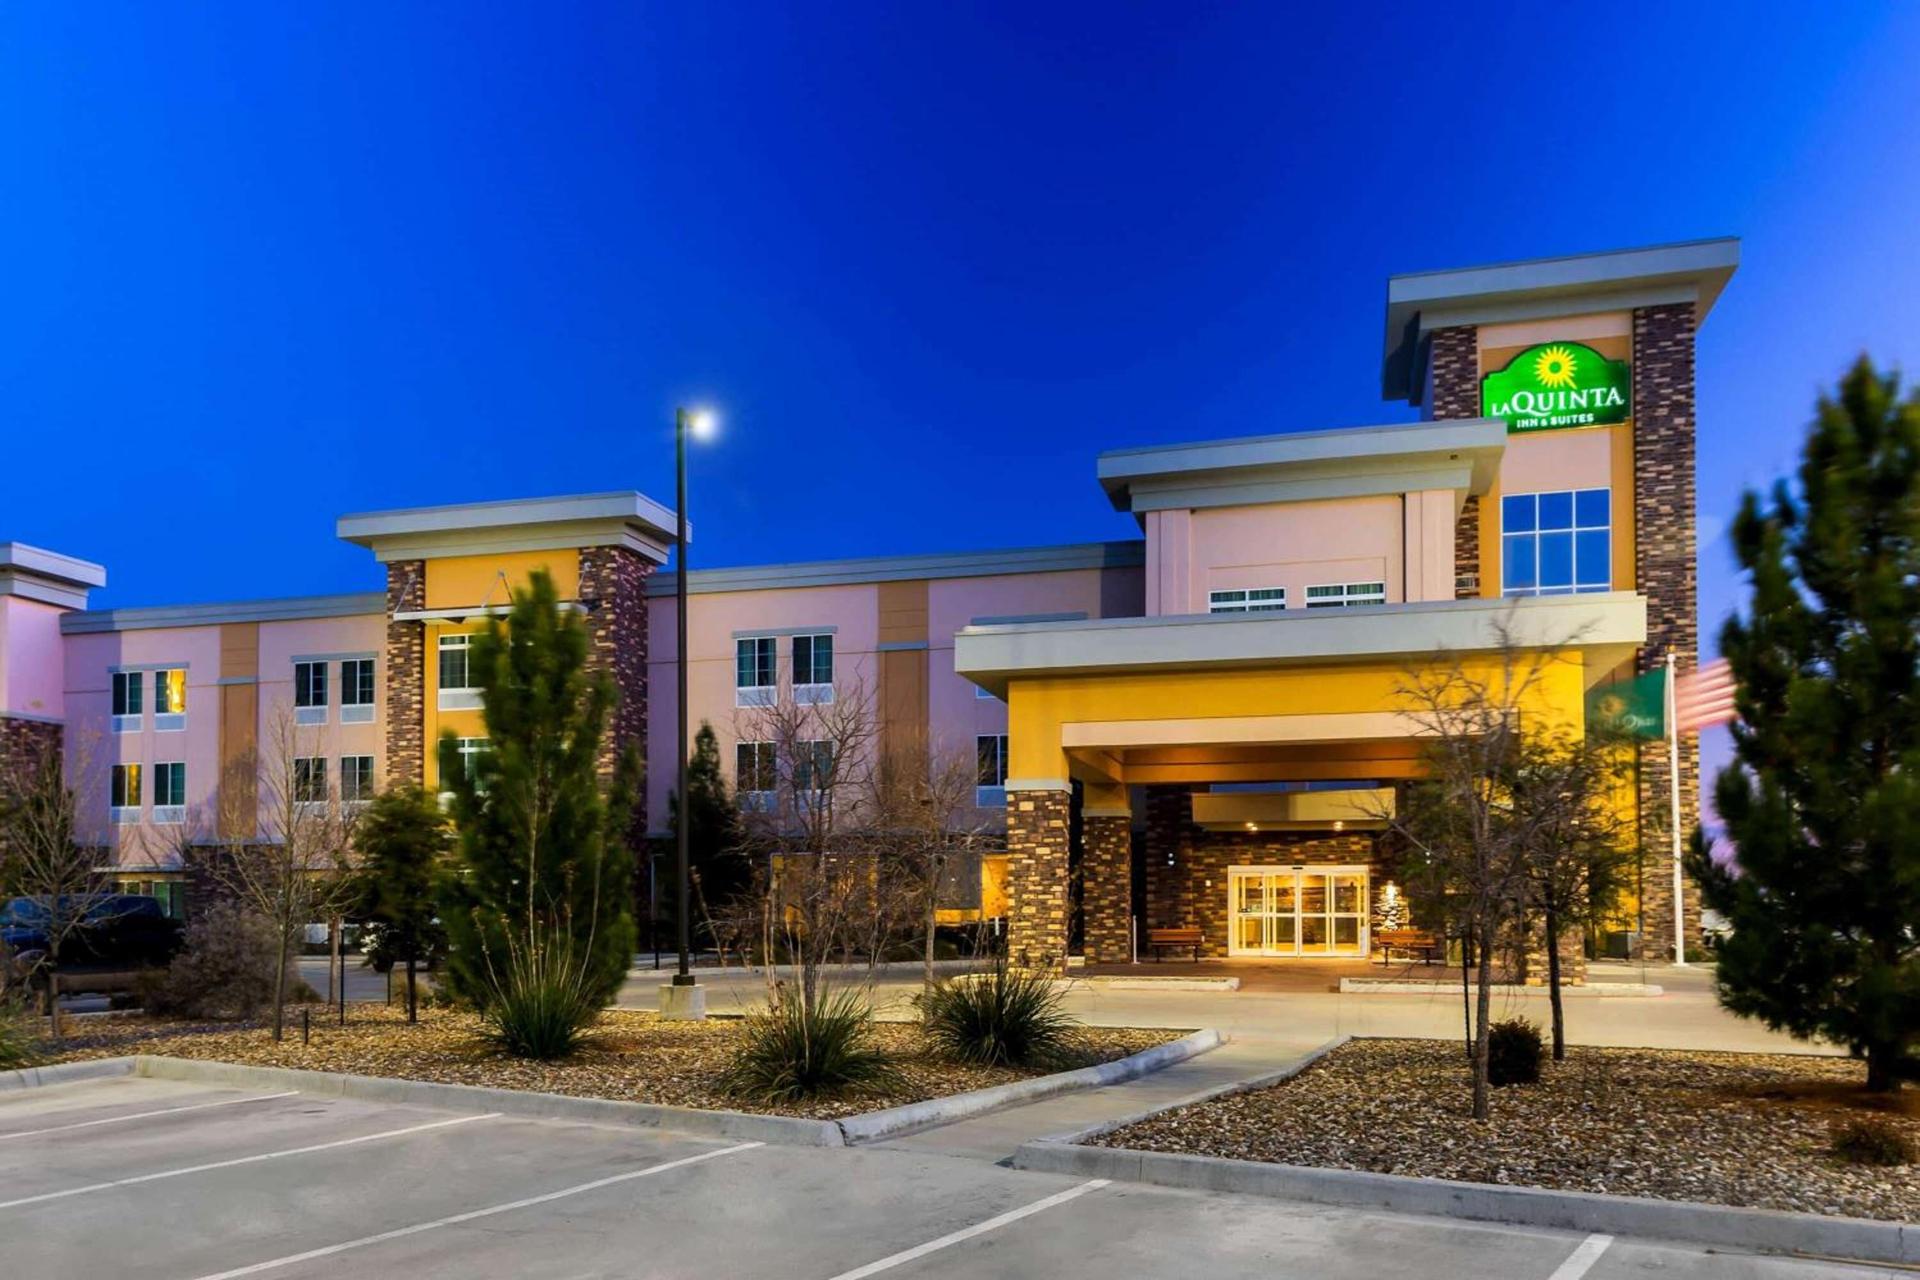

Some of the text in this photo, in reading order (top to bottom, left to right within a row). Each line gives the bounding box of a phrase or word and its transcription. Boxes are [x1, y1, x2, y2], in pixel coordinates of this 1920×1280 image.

[1511, 387, 1625, 417] QUINTA
[1517, 418, 1538, 428] INN
[1551, 413, 1594, 426] SUITES
